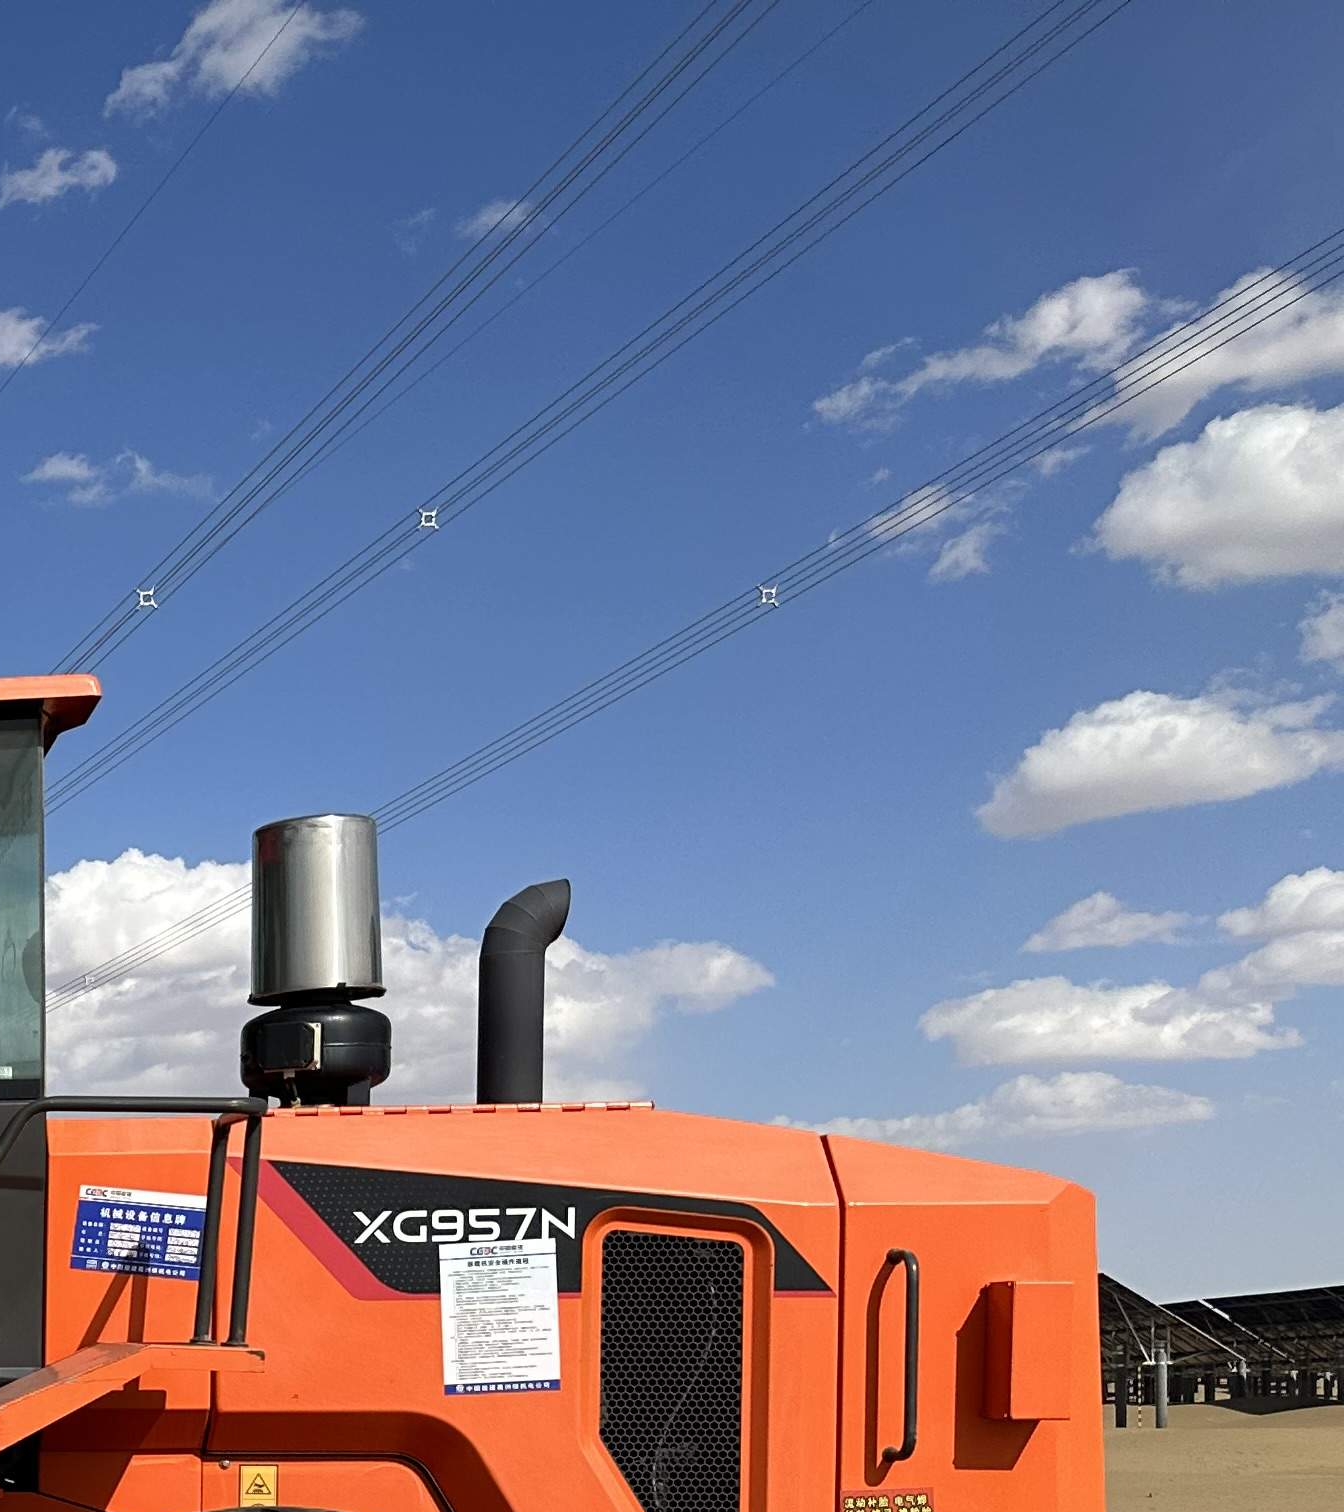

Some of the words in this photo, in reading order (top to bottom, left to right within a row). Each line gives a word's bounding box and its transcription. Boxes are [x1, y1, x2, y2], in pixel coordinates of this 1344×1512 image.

[100, 1207, 187, 1226] 机械设备信息牌
[352, 1207, 576, 1244] XG957N
